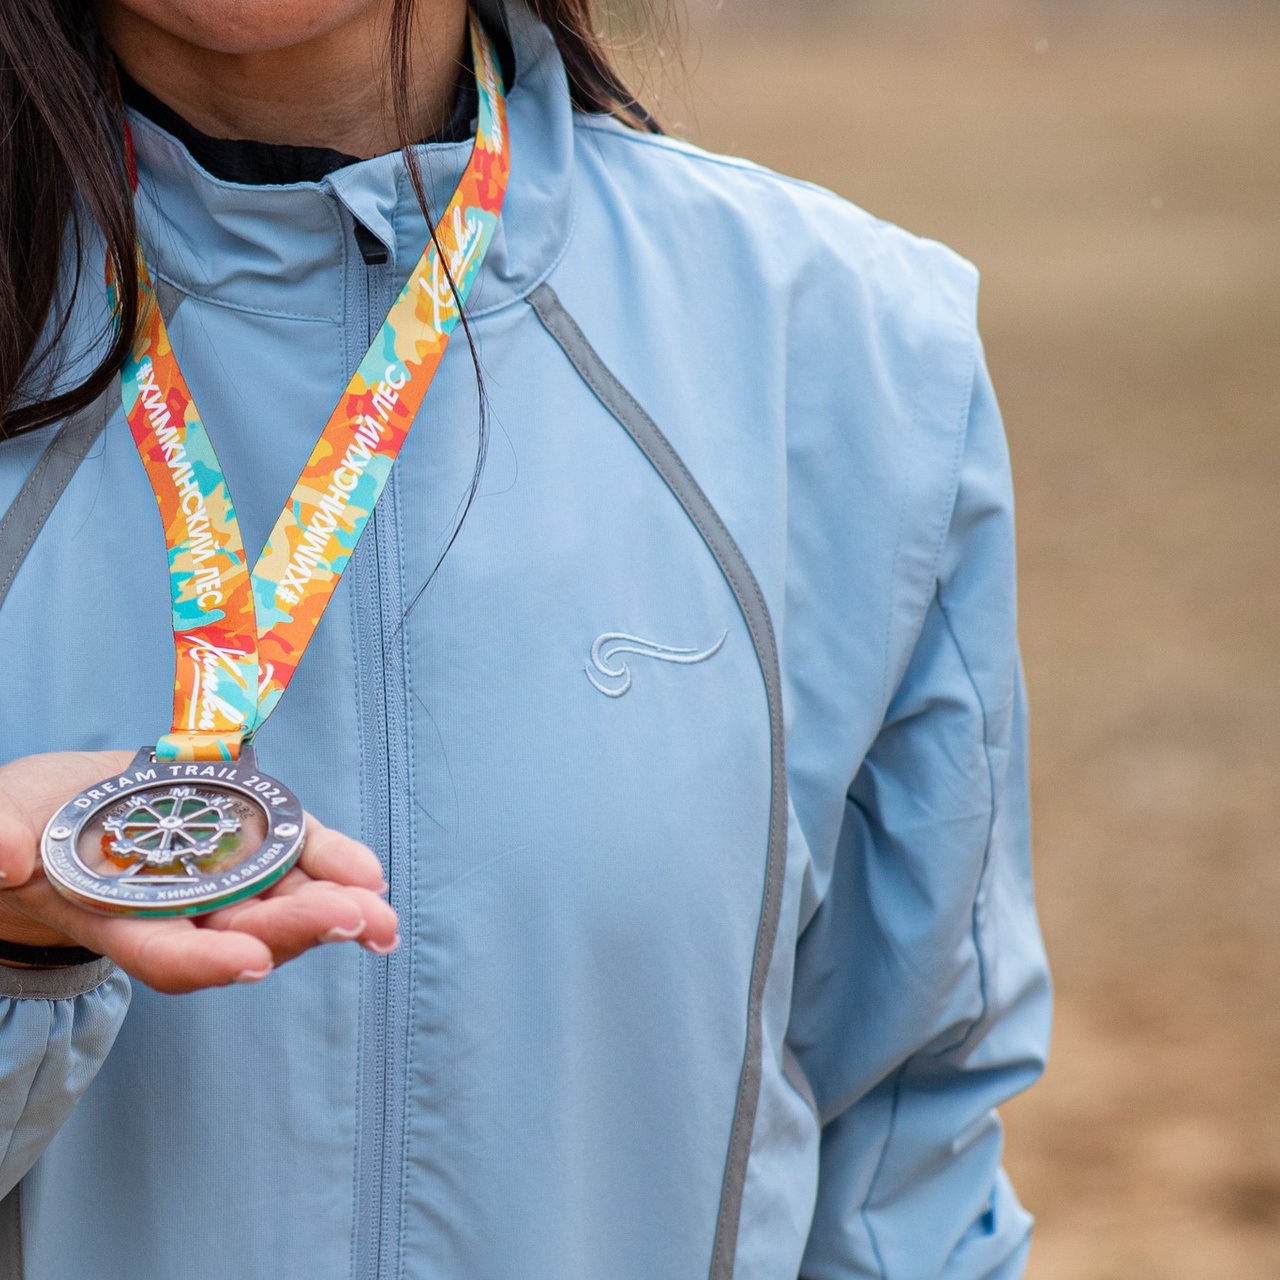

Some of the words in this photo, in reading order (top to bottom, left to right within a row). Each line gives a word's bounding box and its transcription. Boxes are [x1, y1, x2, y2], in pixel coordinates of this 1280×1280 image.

[135, 363, 220, 565] #ХИМКИНСКИЙ
[194, 566, 224, 608] ЛЕС
[275, 412, 381, 605] #ХИМКИНСКИЙ
[370, 363, 408, 424] ЛЕС
[74, 768, 157, 809] DREAM
[169, 765, 237, 780] TRAIL
[242, 775, 289, 807] 2024
[52, 846, 118, 897] СПАРТАКИАДА
[157, 882, 217, 900] ХИМКИ
[221, 842, 285, 886] 14.04.2024
